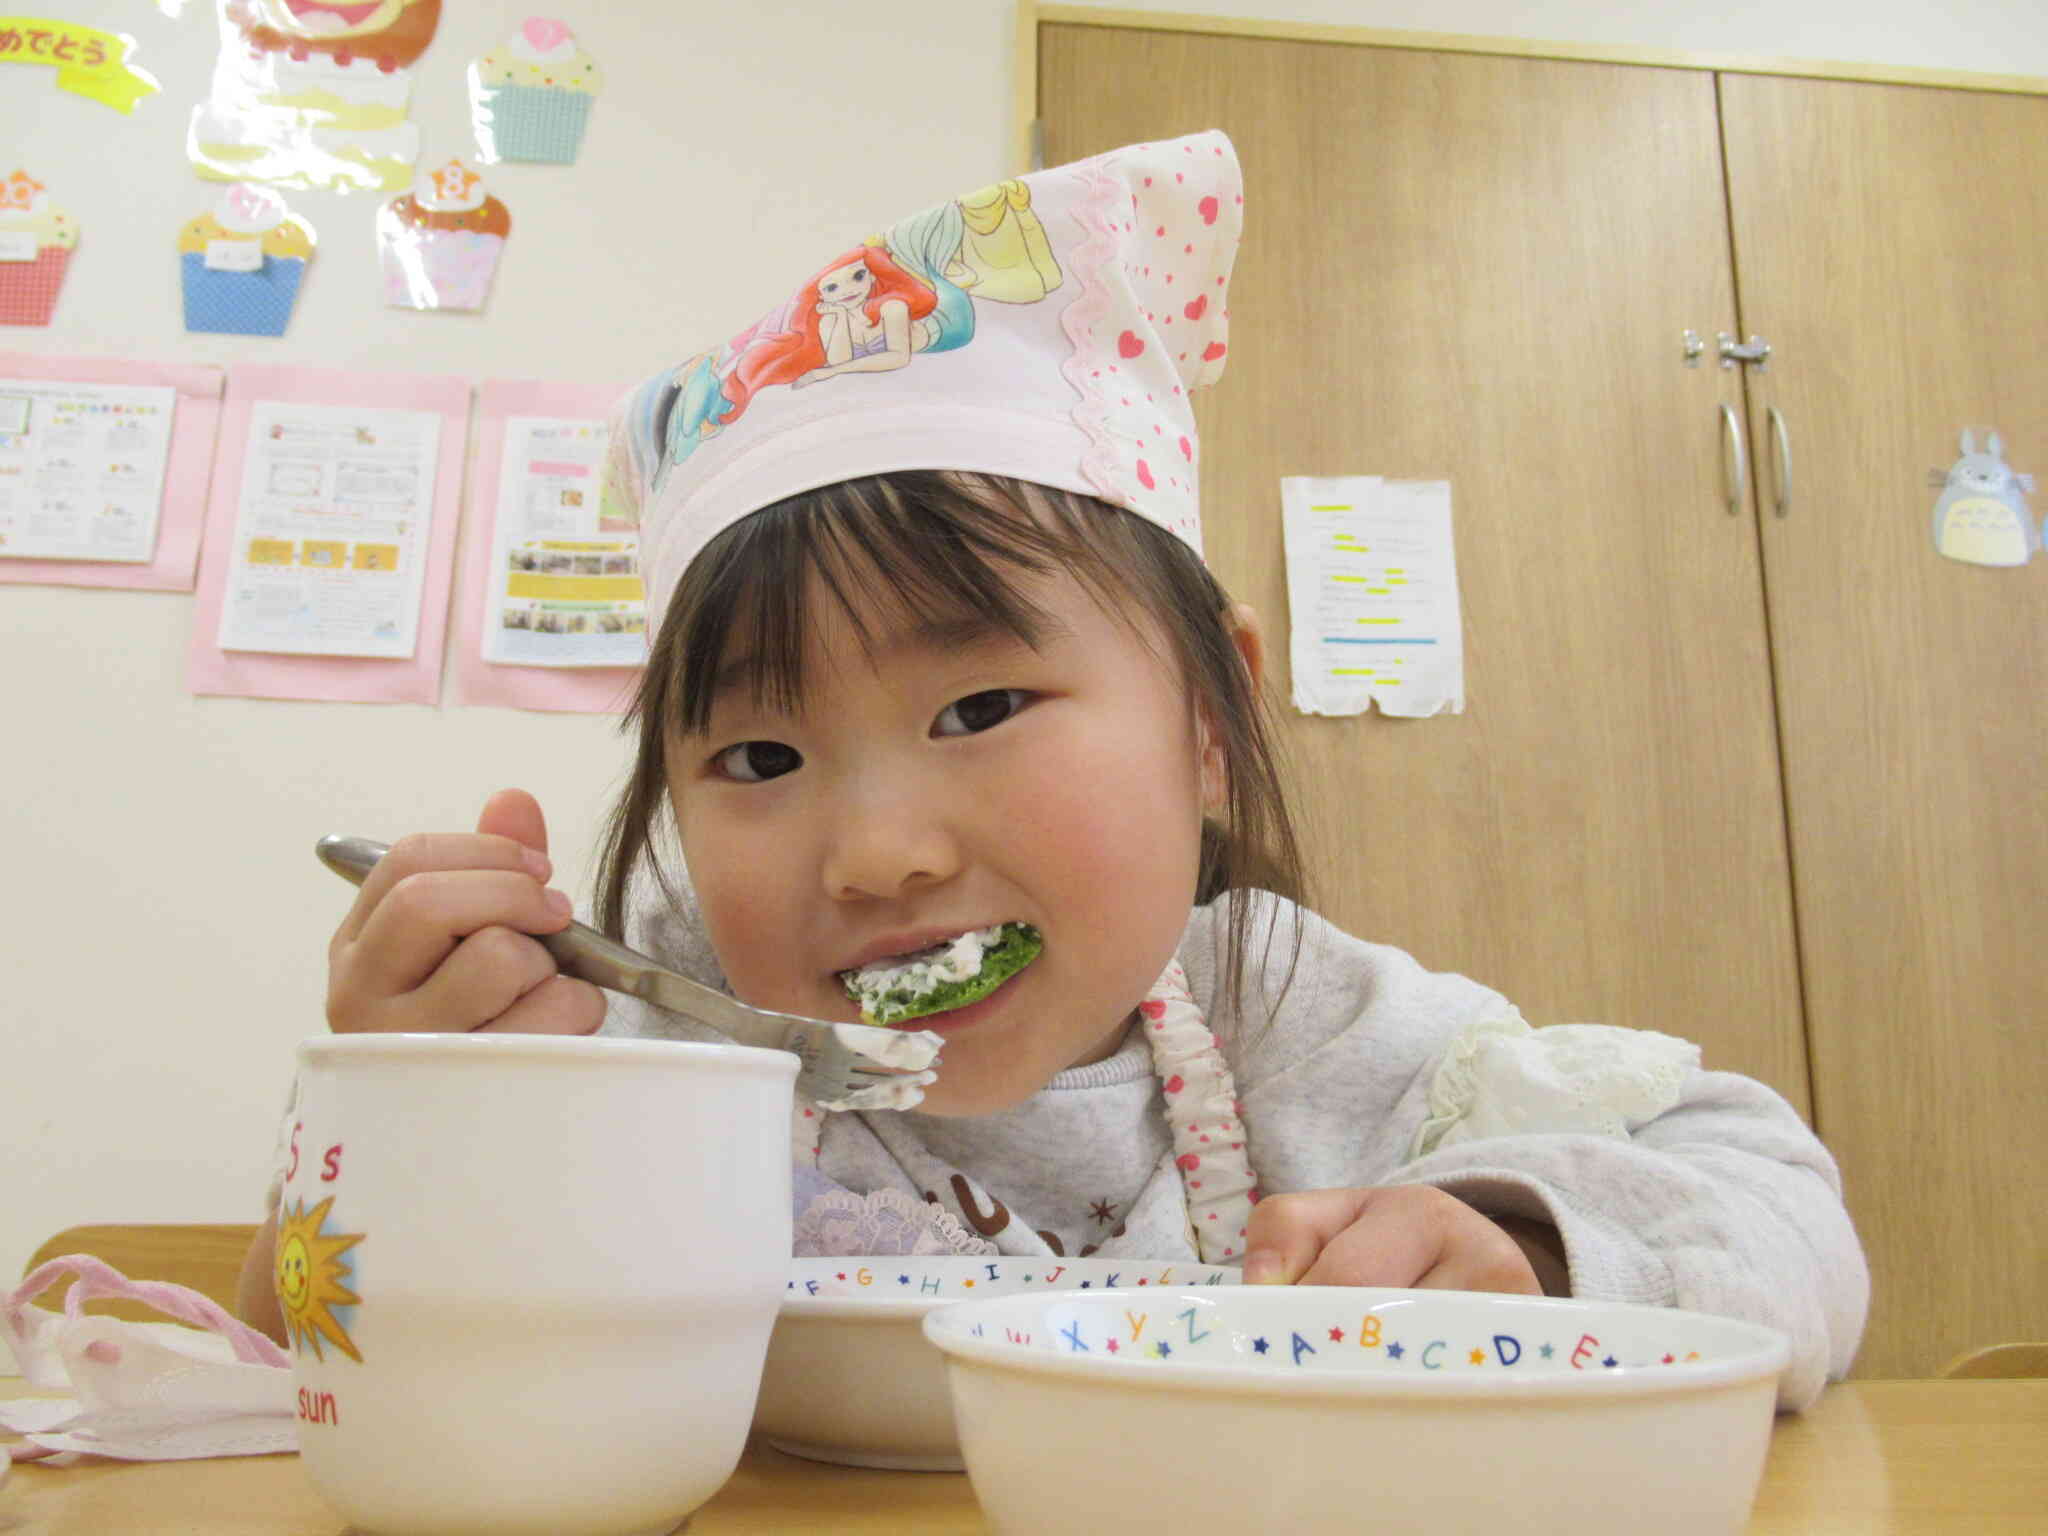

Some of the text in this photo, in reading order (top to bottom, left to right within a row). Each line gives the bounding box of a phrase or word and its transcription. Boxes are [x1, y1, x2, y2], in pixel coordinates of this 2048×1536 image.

[806, 1280, 820, 1296] F
[857, 1267, 873, 1286] G
[920, 1274, 941, 1295] H
[985, 1264, 1000, 1281] I
[1046, 1266, 1066, 1283] J
[1106, 1272, 1120, 1288] K
[1060, 1320, 1089, 1351] X
[1126, 1311, 1148, 1342] Y
[1177, 1308, 1211, 1343] Z
[1292, 1331, 1317, 1366] A
[1360, 1315, 1380, 1347] B
[1421, 1341, 1446, 1369] C
[1494, 1335, 1521, 1366] D
[1571, 1334, 1599, 1370] E
[298, 1386, 337, 1426] sun
